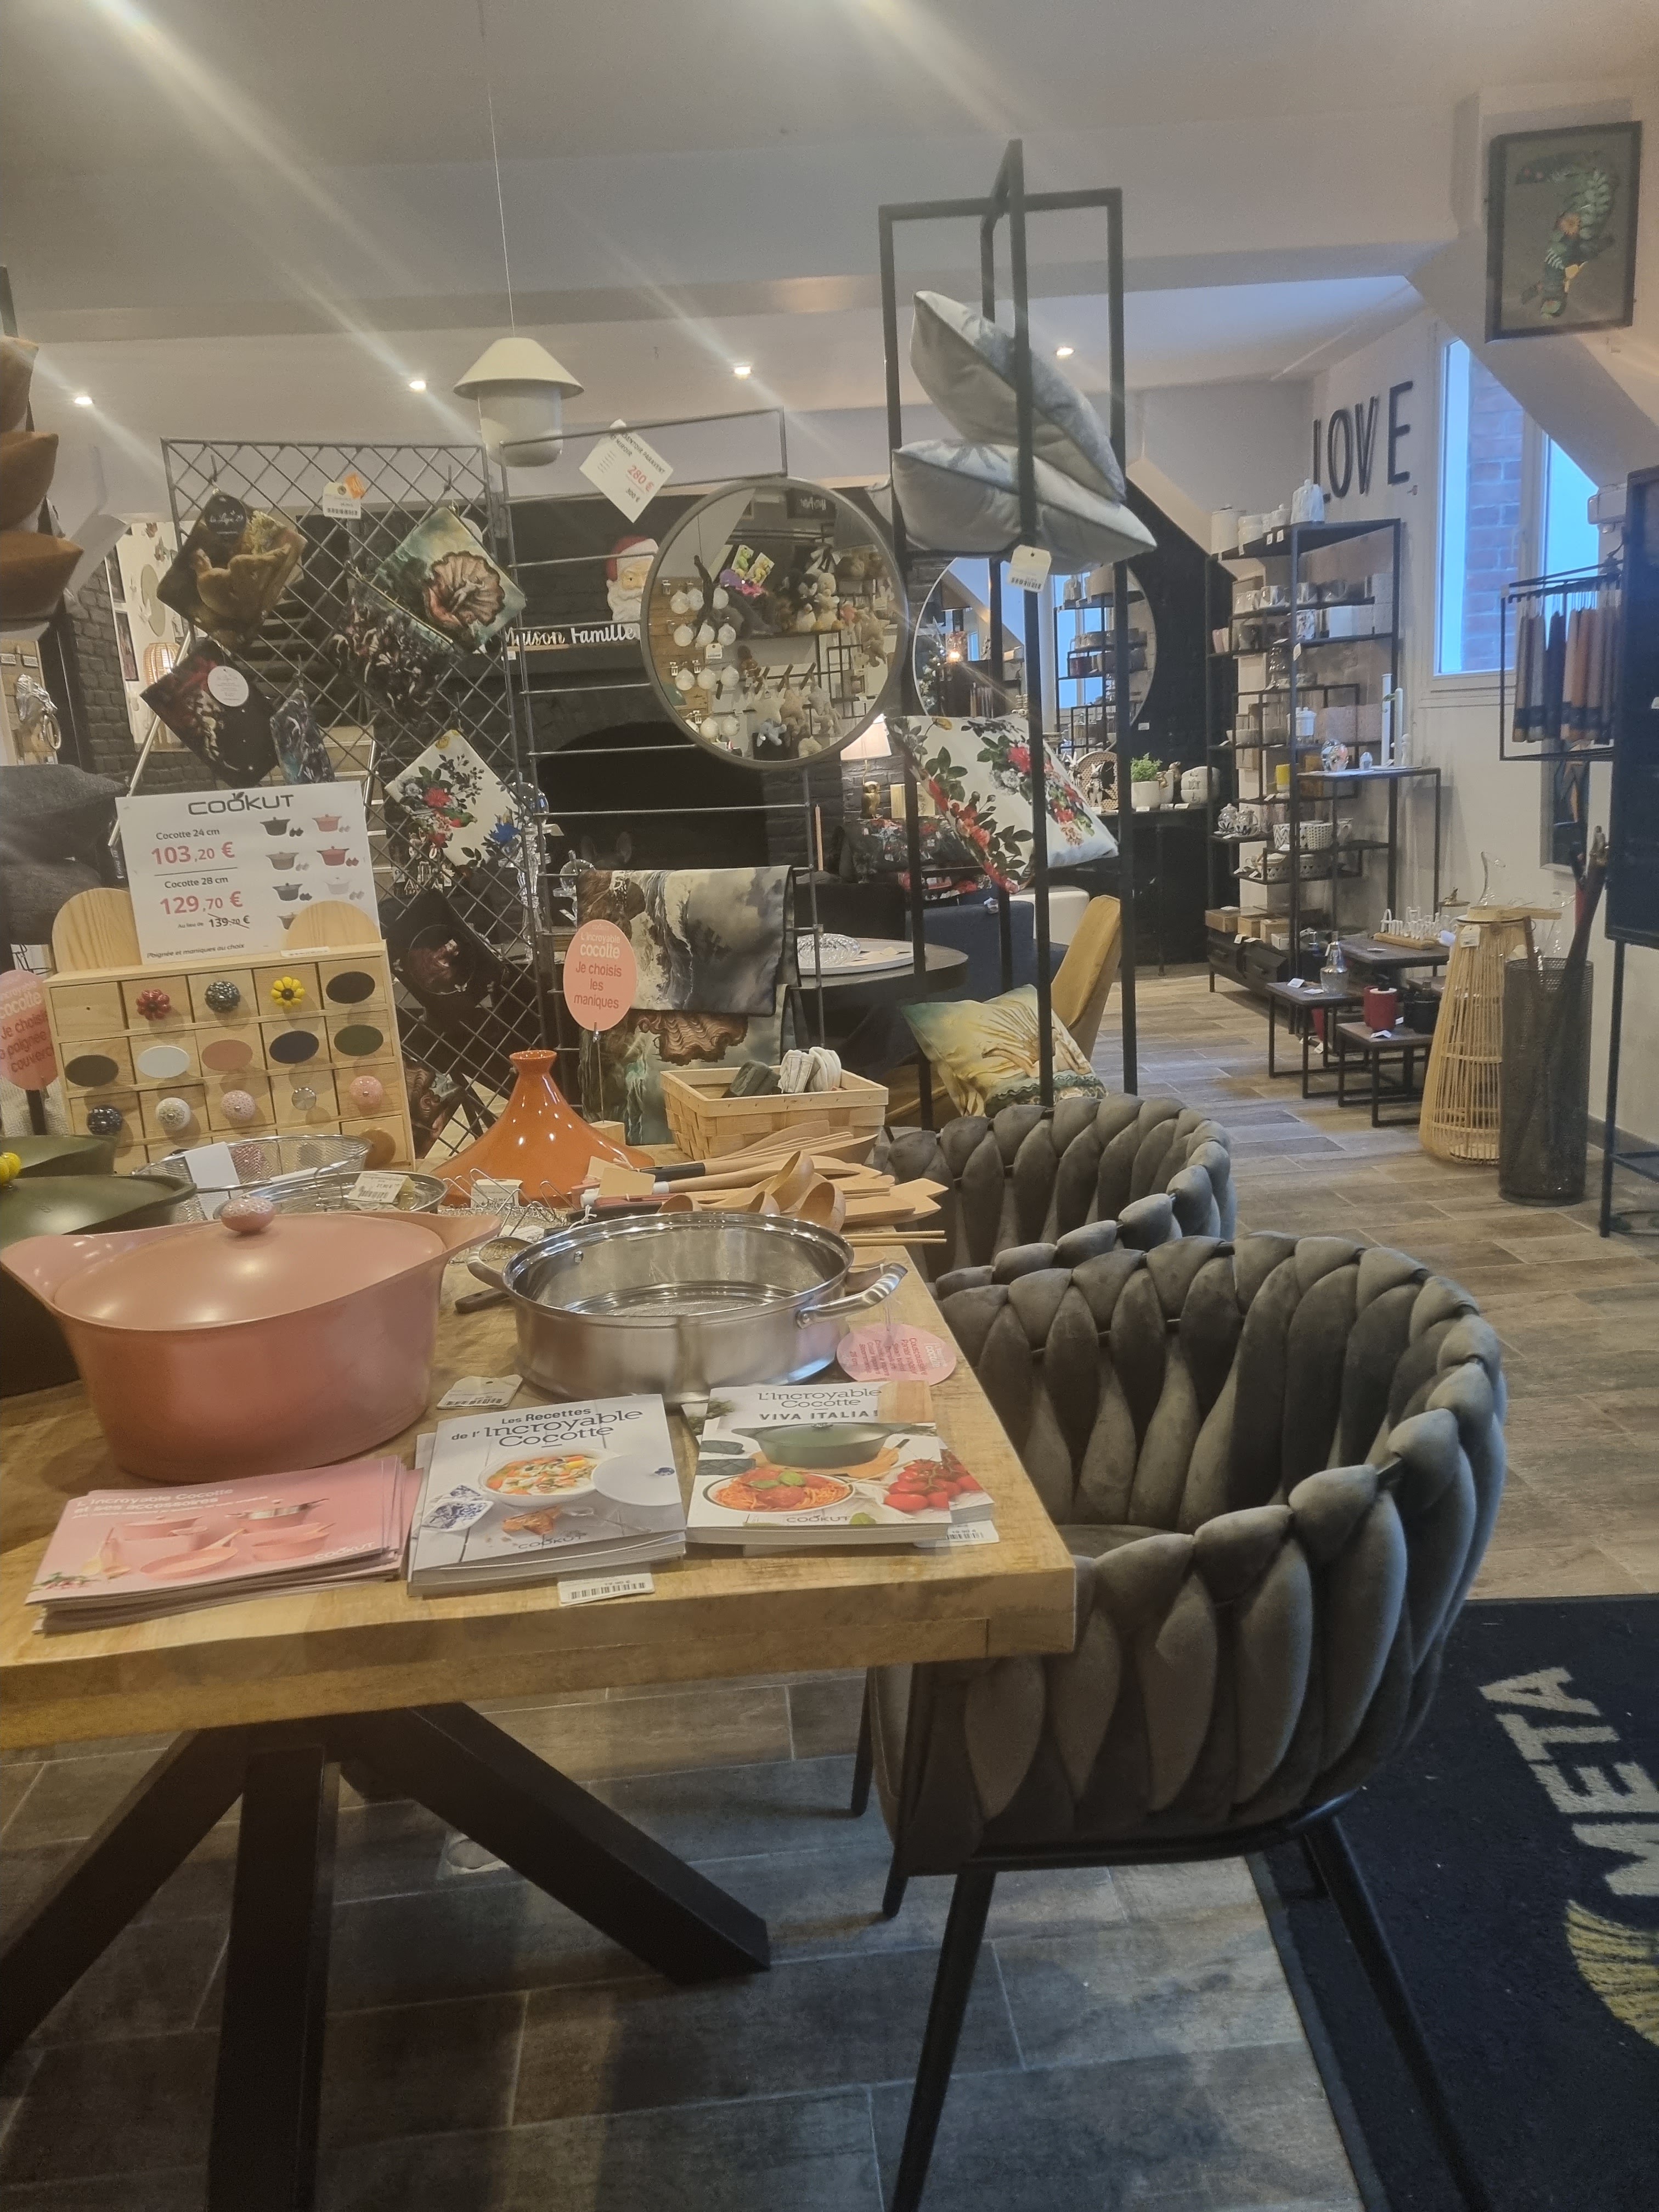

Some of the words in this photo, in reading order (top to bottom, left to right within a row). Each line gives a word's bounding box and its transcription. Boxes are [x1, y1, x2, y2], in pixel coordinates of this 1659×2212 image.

[1313, 381, 1414, 503] LOVE
[627, 465, 647, 484] 280
[645, 480, 655, 492] €
[188, 793, 295, 815] COOKUT
[156, 831, 191, 840] Cocotte
[193, 828, 205, 837] 24
[221, 842, 235, 858] €
[165, 879, 200, 888] Cocotte
[201, 877, 213, 885] 28
[229, 890, 243, 907] €
[242, 915, 251, 924] €
[580, 933, 621, 944] L'incroyable
[183, 946, 216, 955] maniques
[580, 943, 621, 959] cocotte
[575, 961, 586, 973] Je
[588, 963, 622, 978] choisis
[590, 978, 604, 991] les
[573, 994, 619, 1009] maniques
[2, 1026, 13, 1040] Je
[758, 1389, 882, 1400] L'Incroyable
[781, 1399, 860, 1408] Cocotte
[501, 1417, 522, 1425] Les
[526, 1408, 591, 1423] Recettes
[452, 1432, 467, 1441] de
[499, 1426, 614, 1447] Cocotte
[176, 1488, 234, 1500] Cocotte
[786, 1515, 848, 1523] COOKUT
